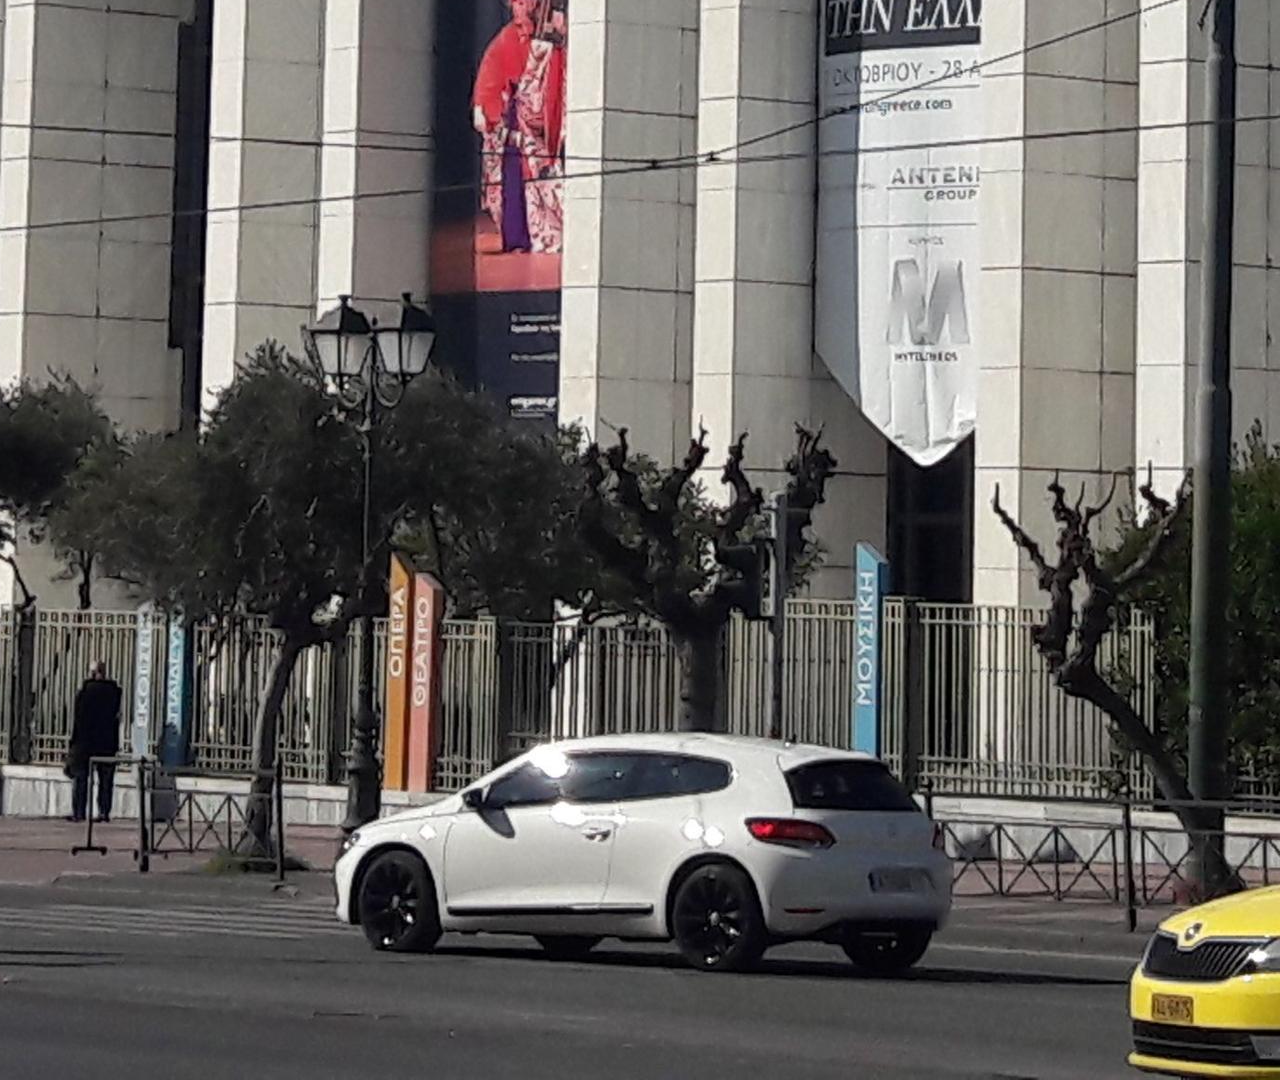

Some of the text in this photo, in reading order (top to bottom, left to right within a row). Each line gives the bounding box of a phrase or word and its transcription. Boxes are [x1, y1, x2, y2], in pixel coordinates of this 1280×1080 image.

[923, 188, 977, 201] GROUP
[390, 587, 406, 677] ΟΠΕΡΑ
[413, 596, 431, 707] ΘΕΑΤΡΟ
[856, 571, 874, 707] ΜΟΥΣΙΚΗ
